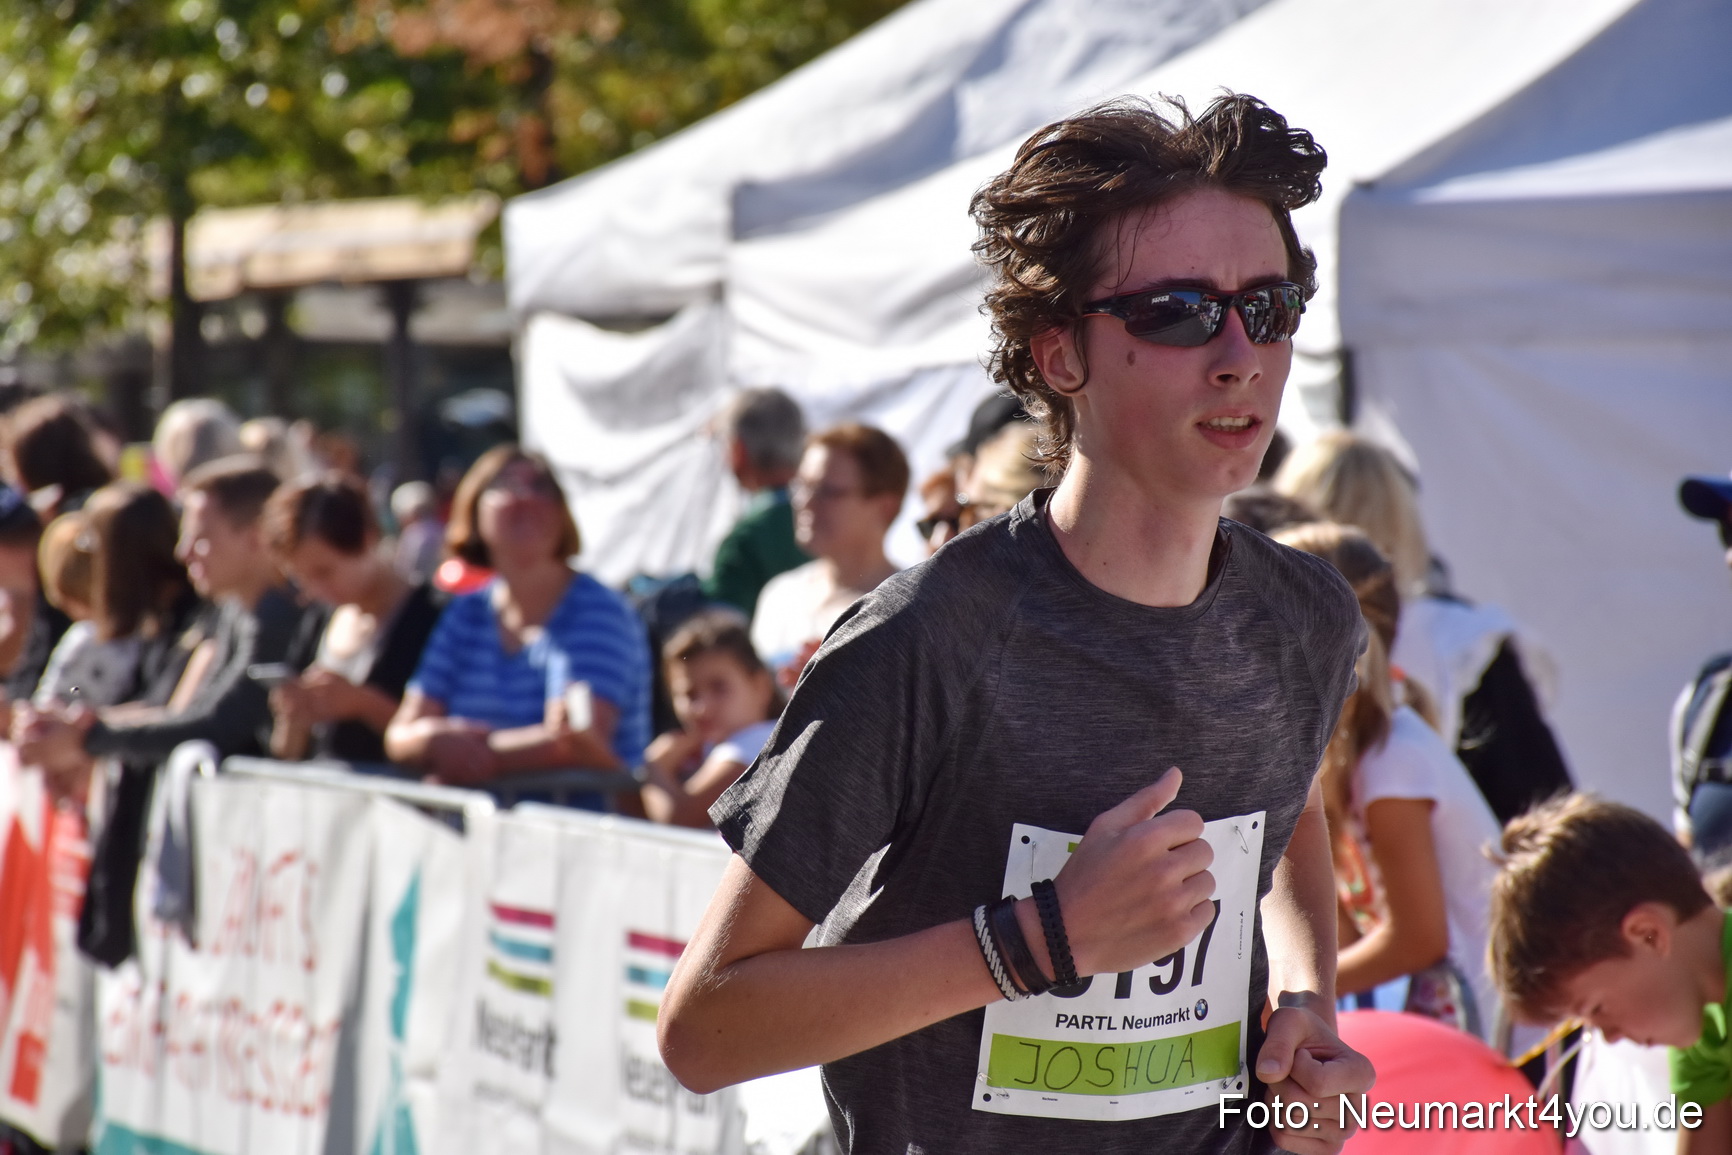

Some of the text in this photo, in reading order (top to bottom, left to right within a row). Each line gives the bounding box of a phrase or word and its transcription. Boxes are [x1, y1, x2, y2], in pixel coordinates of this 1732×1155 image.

[1055, 1013, 1117, 1031] PARTL
[1122, 1007, 1190, 1030] Neumarkt
[1013, 1037, 1195, 1090] JOSHUA
